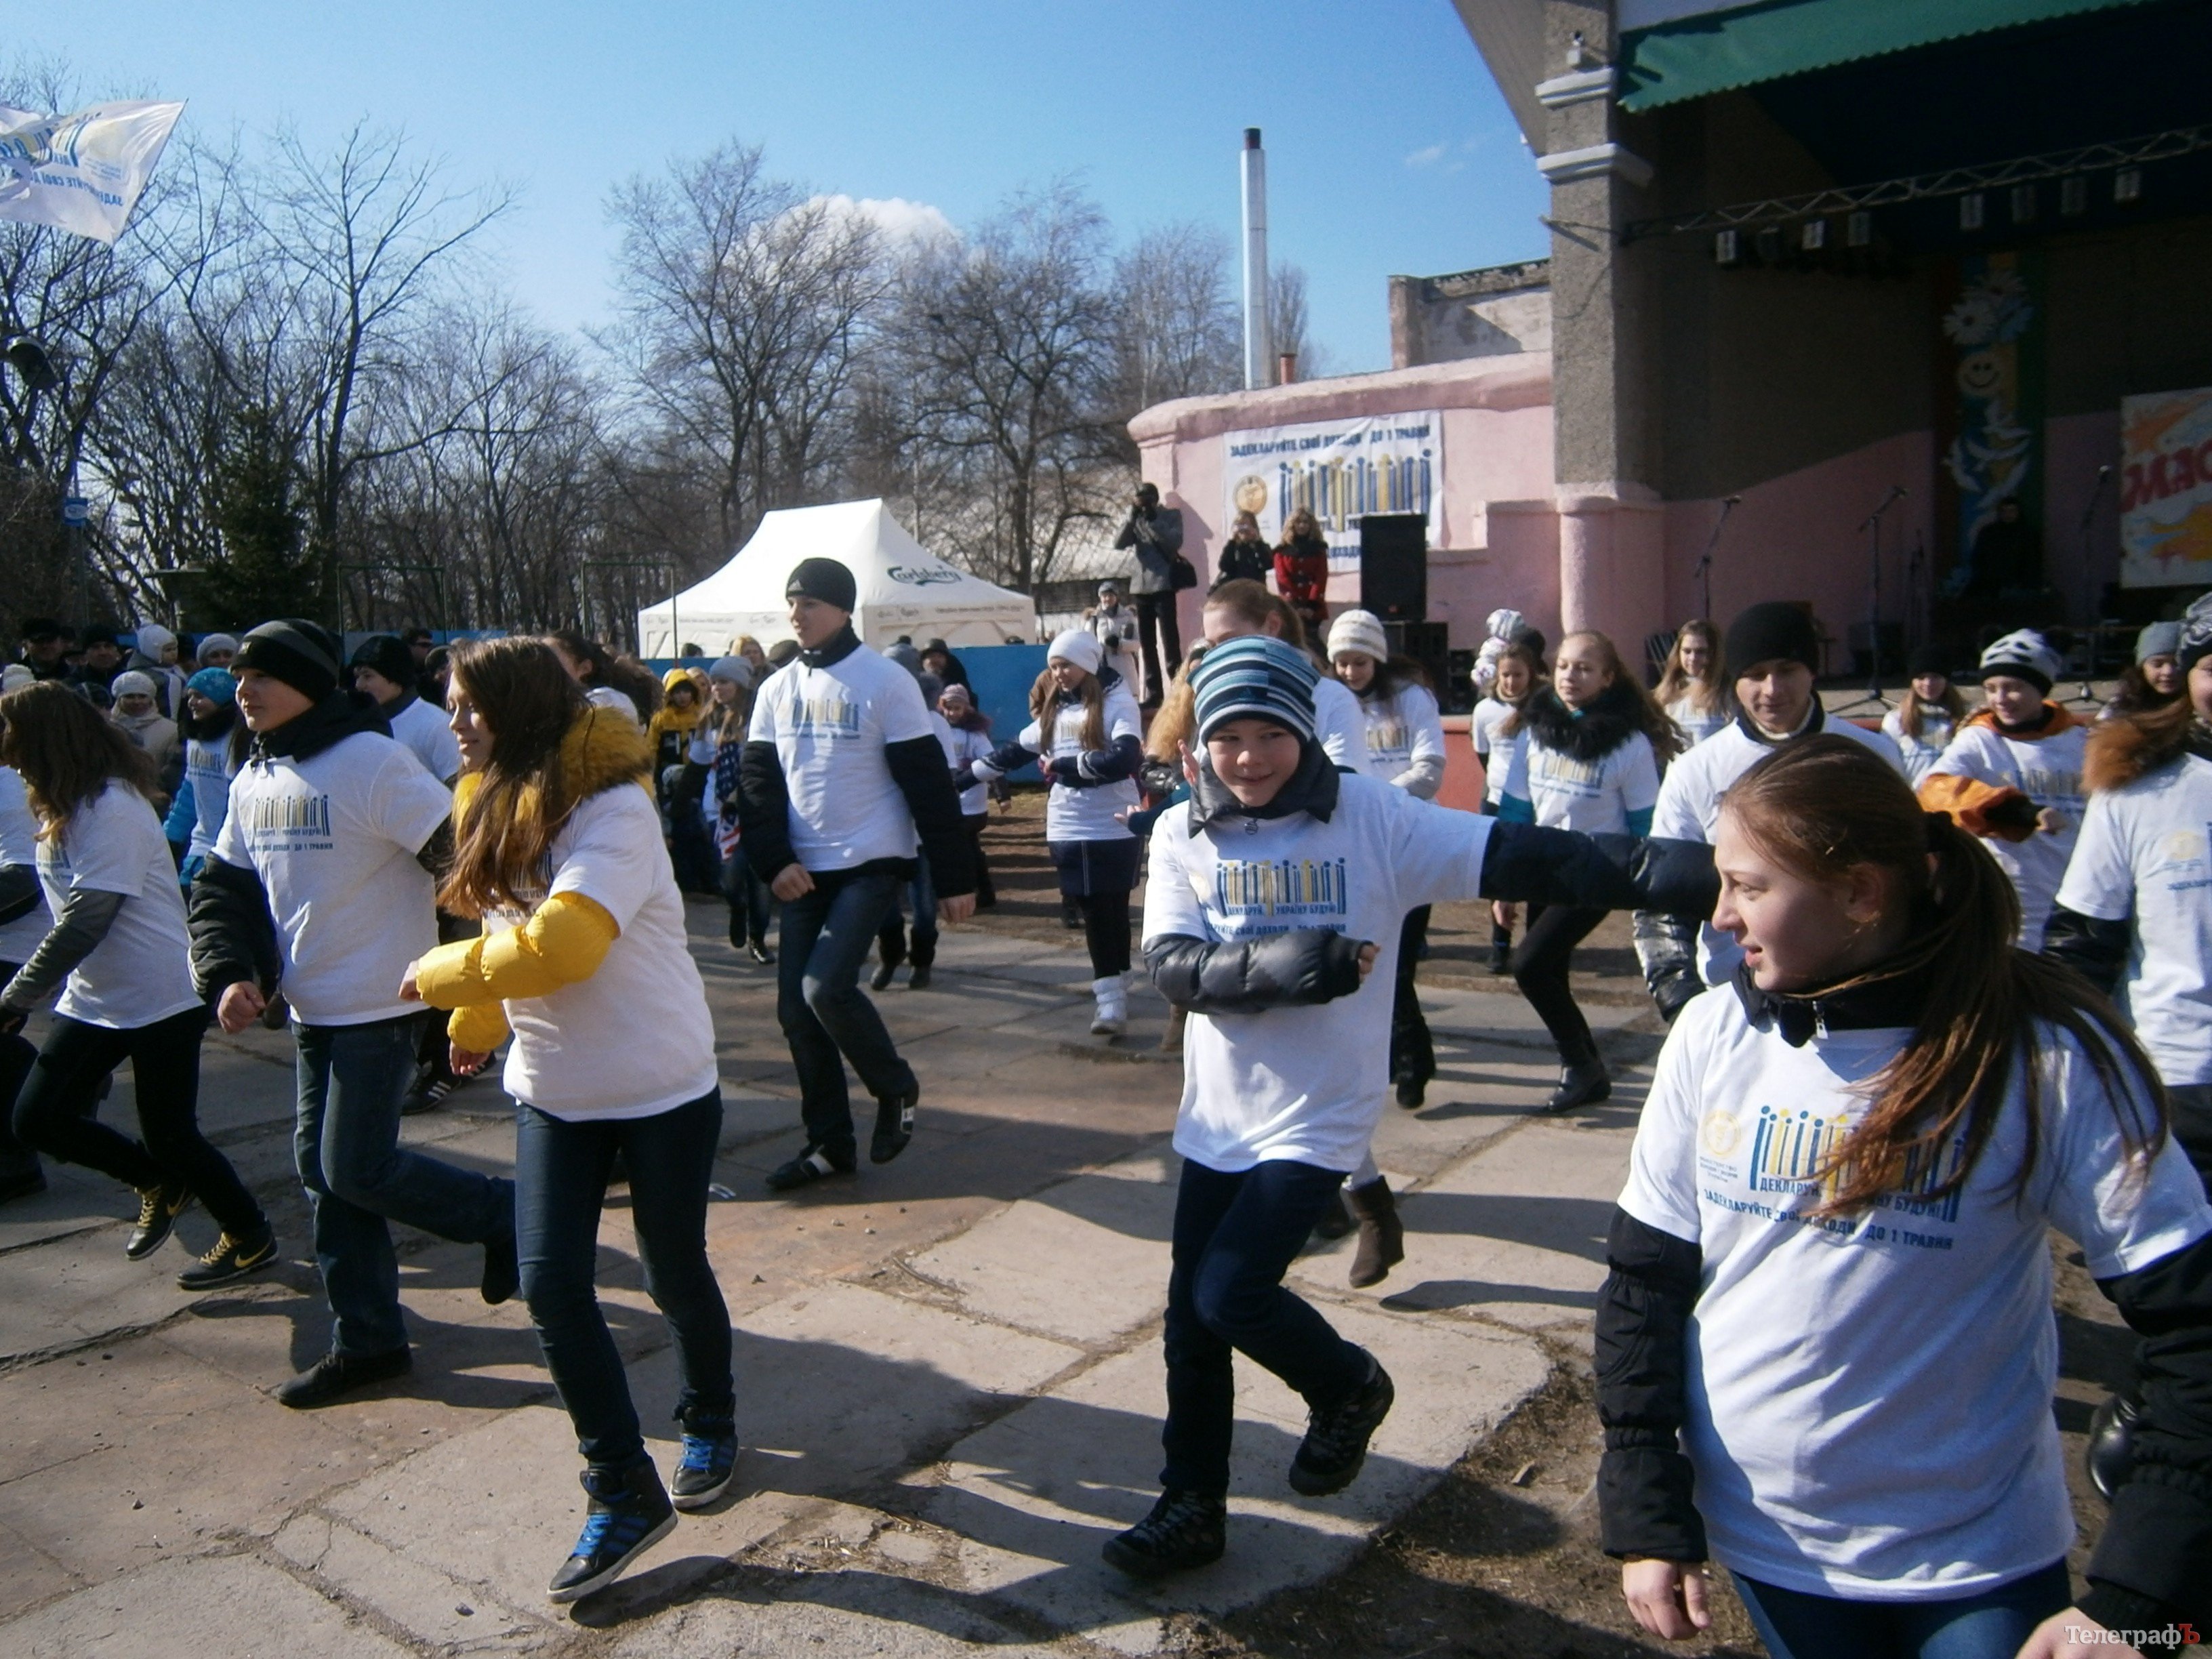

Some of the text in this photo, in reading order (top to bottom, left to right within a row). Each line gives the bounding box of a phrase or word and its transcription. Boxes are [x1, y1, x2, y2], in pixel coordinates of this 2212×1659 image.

[1704, 1188, 1773, 1219] ЗАДЕКЛАРУЙТЕ
[1865, 1224, 1886, 1241] ДО
[1891, 1229, 1898, 1244] 1
[1903, 1231, 1953, 1251] ТРАВНЯ
